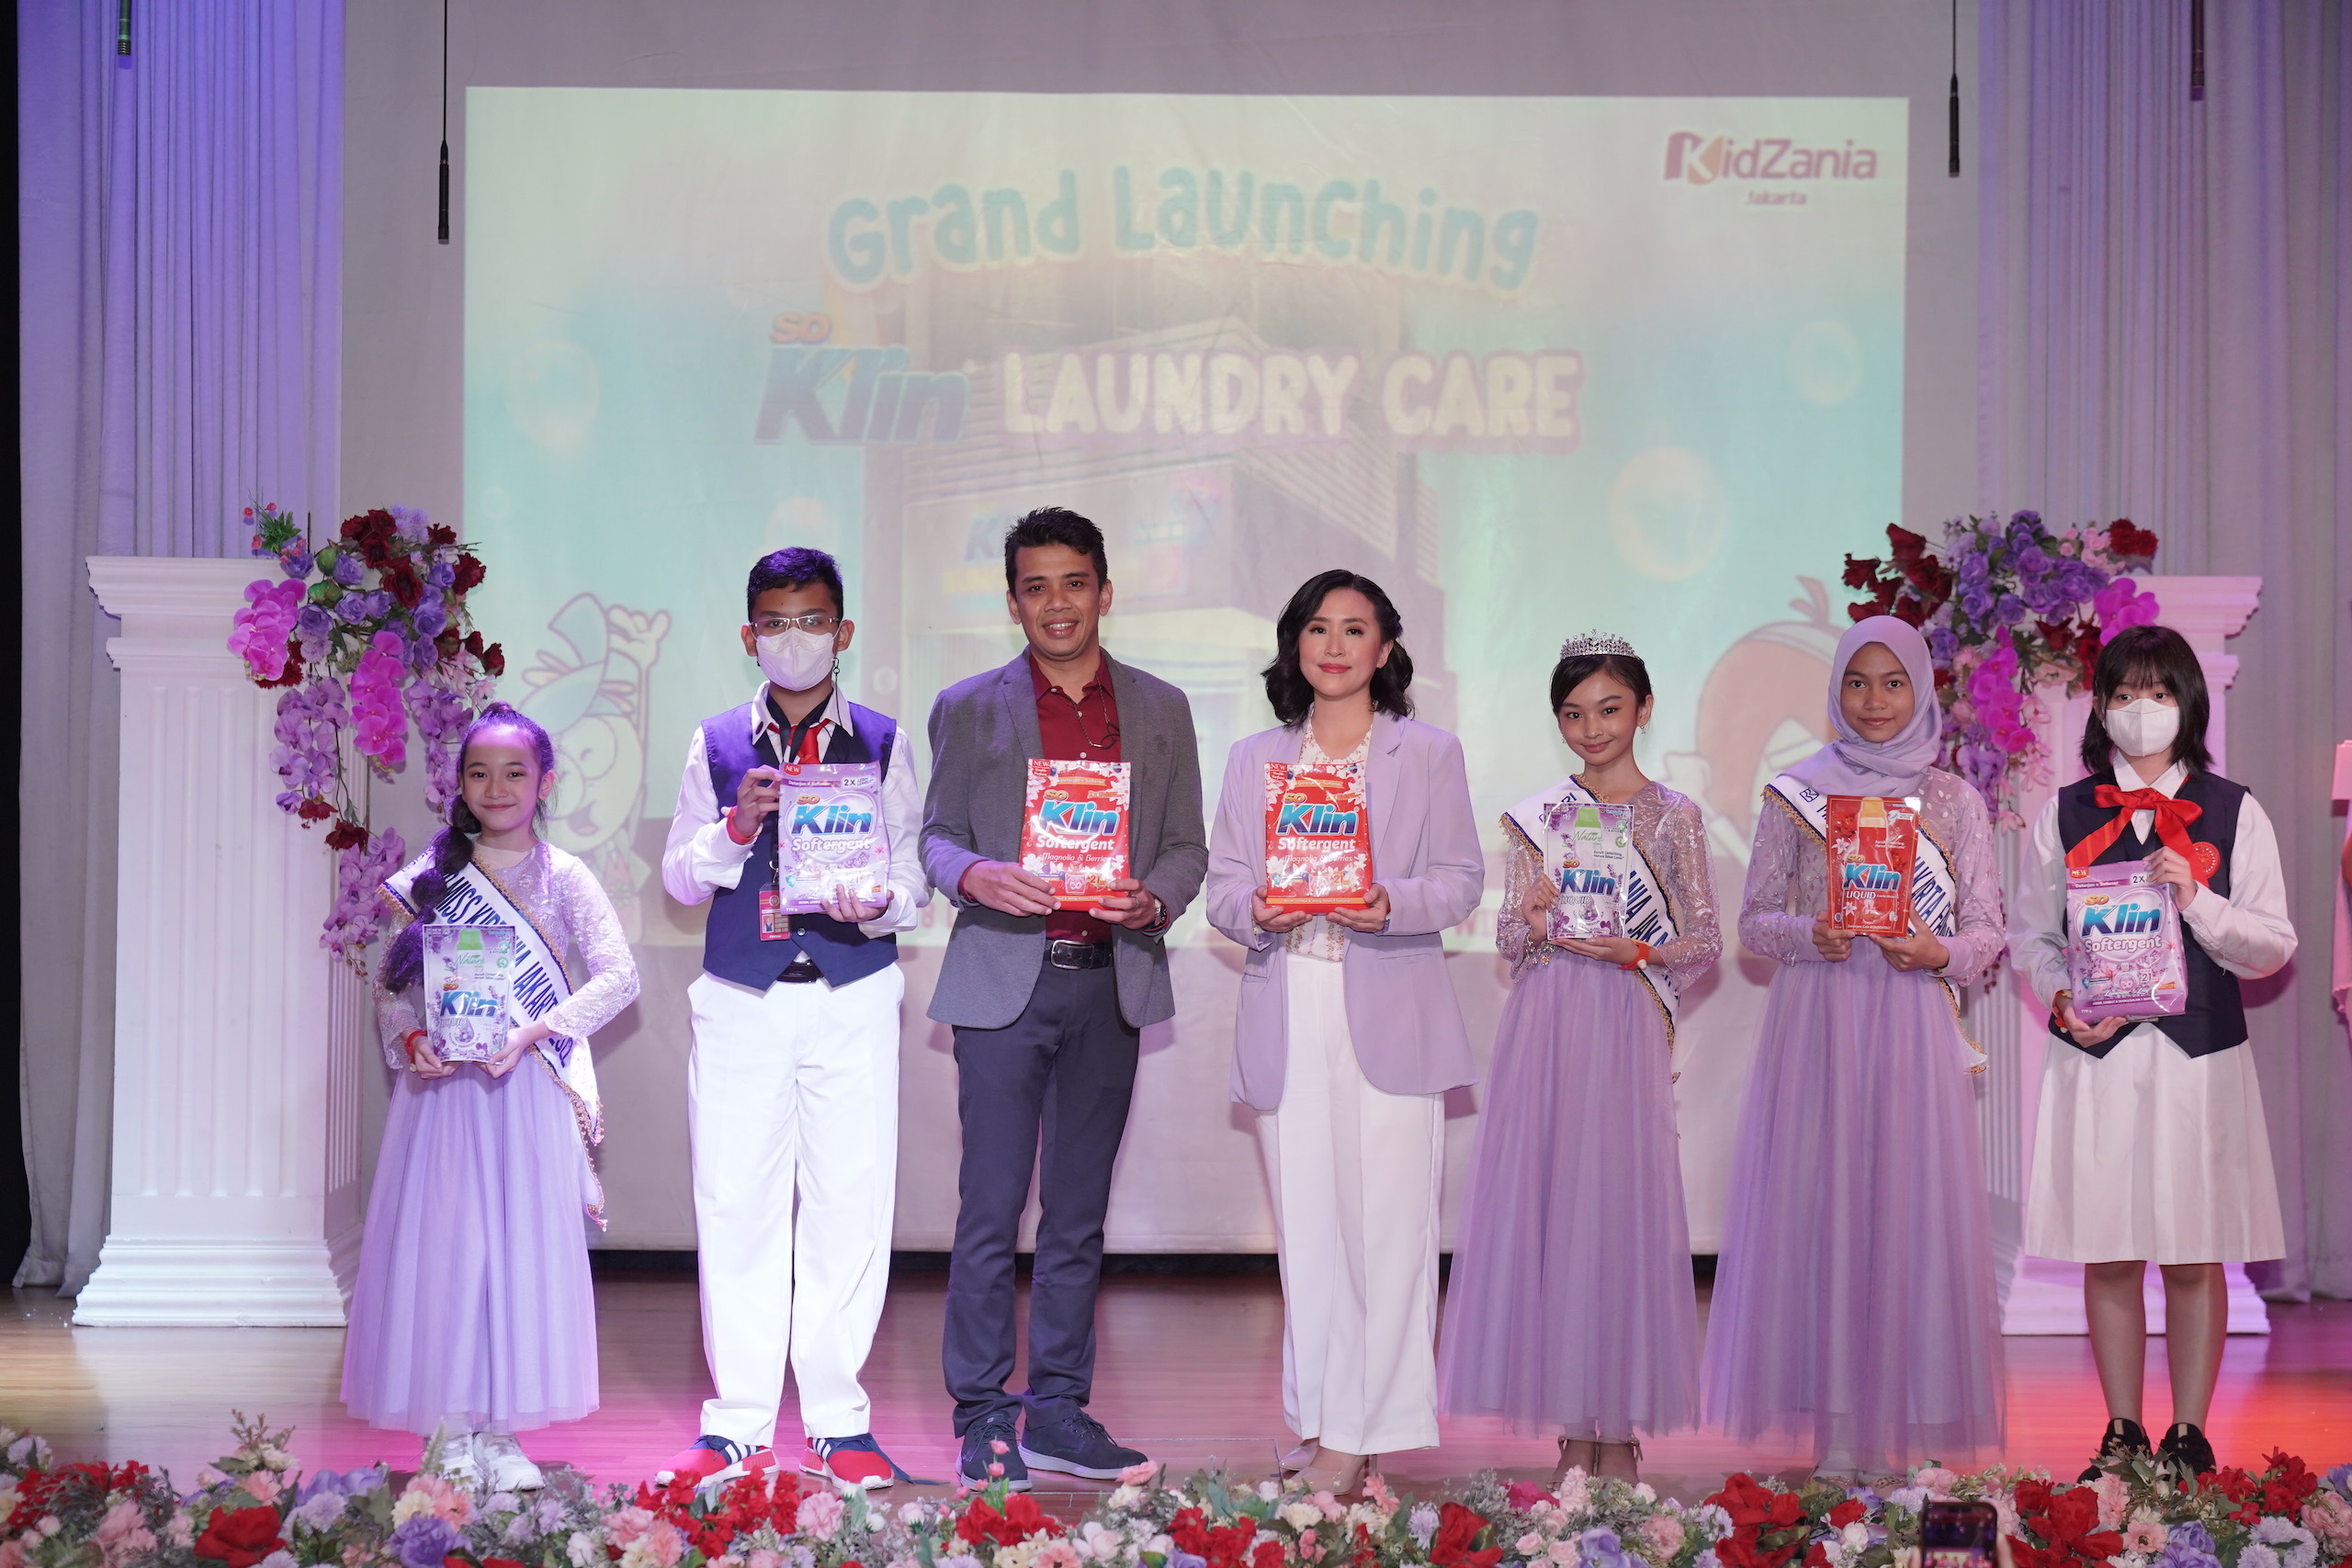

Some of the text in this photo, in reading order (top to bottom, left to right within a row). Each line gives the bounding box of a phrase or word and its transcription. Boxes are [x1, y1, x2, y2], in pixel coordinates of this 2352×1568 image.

[1663, 130, 1877, 186] KidZania
[1745, 189, 1807, 207] Jakarta
[829, 164, 1540, 292] Grand Launching
[770, 312, 831, 344] SO
[753, 345, 1581, 446] Klin LAUNDRY CARE
[796, 795, 820, 805] SO
[1044, 790, 1068, 801] SO
[1283, 794, 1306, 804] SO
[791, 805, 873, 835] Klin
[1040, 802, 1119, 834] Klin
[1277, 805, 1358, 834] Klin
[1572, 829, 1604, 842] Nature
[791, 837, 871, 853] Softergent
[1036, 836, 1114, 852] Softergent
[1278, 837, 1356, 852] Softergent
[1042, 852, 1075, 863] Magnolia
[1283, 853, 1317, 863] Magnolia
[1563, 860, 1580, 868] SO
[1847, 855, 1865, 863] SO
[1560, 869, 1616, 896] Klin
[1843, 863, 1901, 890] Klin
[1559, 896, 1590, 906] LIQUID
[1846, 891, 1876, 900] LIQUID
[2086, 895, 2109, 905] SO
[2081, 903, 2161, 937] Klin
[2085, 935, 2162, 953] Softergent
[454, 953, 486, 966] Nature
[2142, 973, 2152, 982] 21
[440, 991, 498, 1017] Klin
